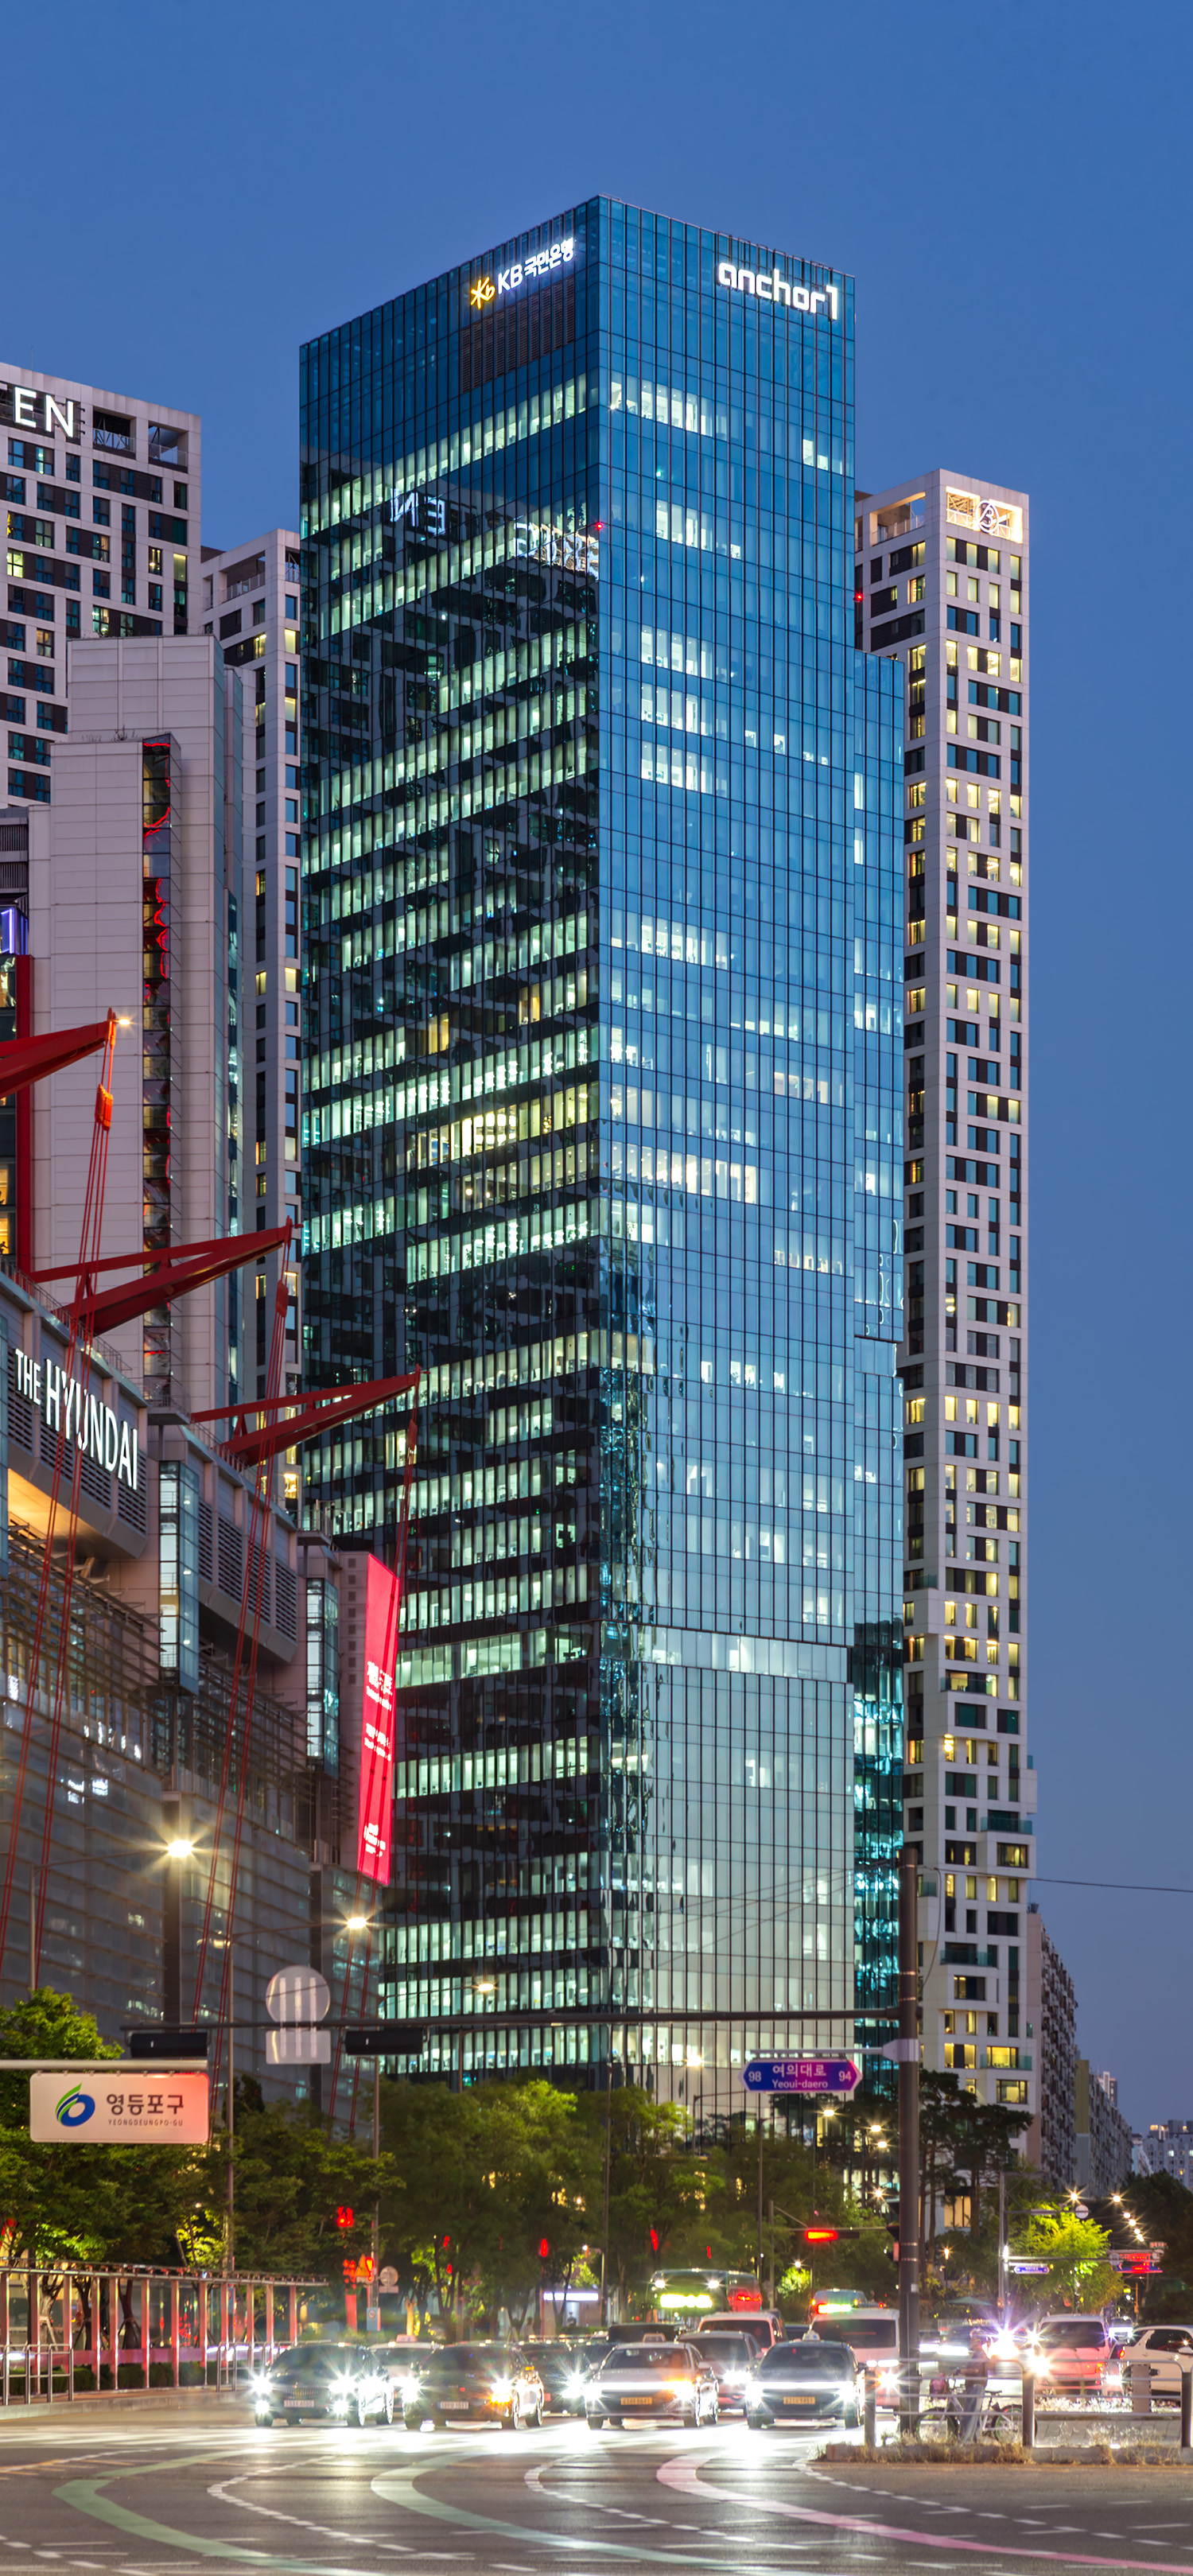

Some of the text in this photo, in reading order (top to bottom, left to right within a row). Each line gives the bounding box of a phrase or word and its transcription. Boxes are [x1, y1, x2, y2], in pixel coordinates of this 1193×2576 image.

[498, 237, 573, 295] KB 국민은행
[719, 262, 837, 320] anchor1
[15, 1348, 138, 1490] THE HYUNDAI
[748, 2064, 852, 2082] 98 여의대로 94
[772, 2079, 828, 2088] Yeoui-daero
[107, 2094, 184, 2116] 영등포구
